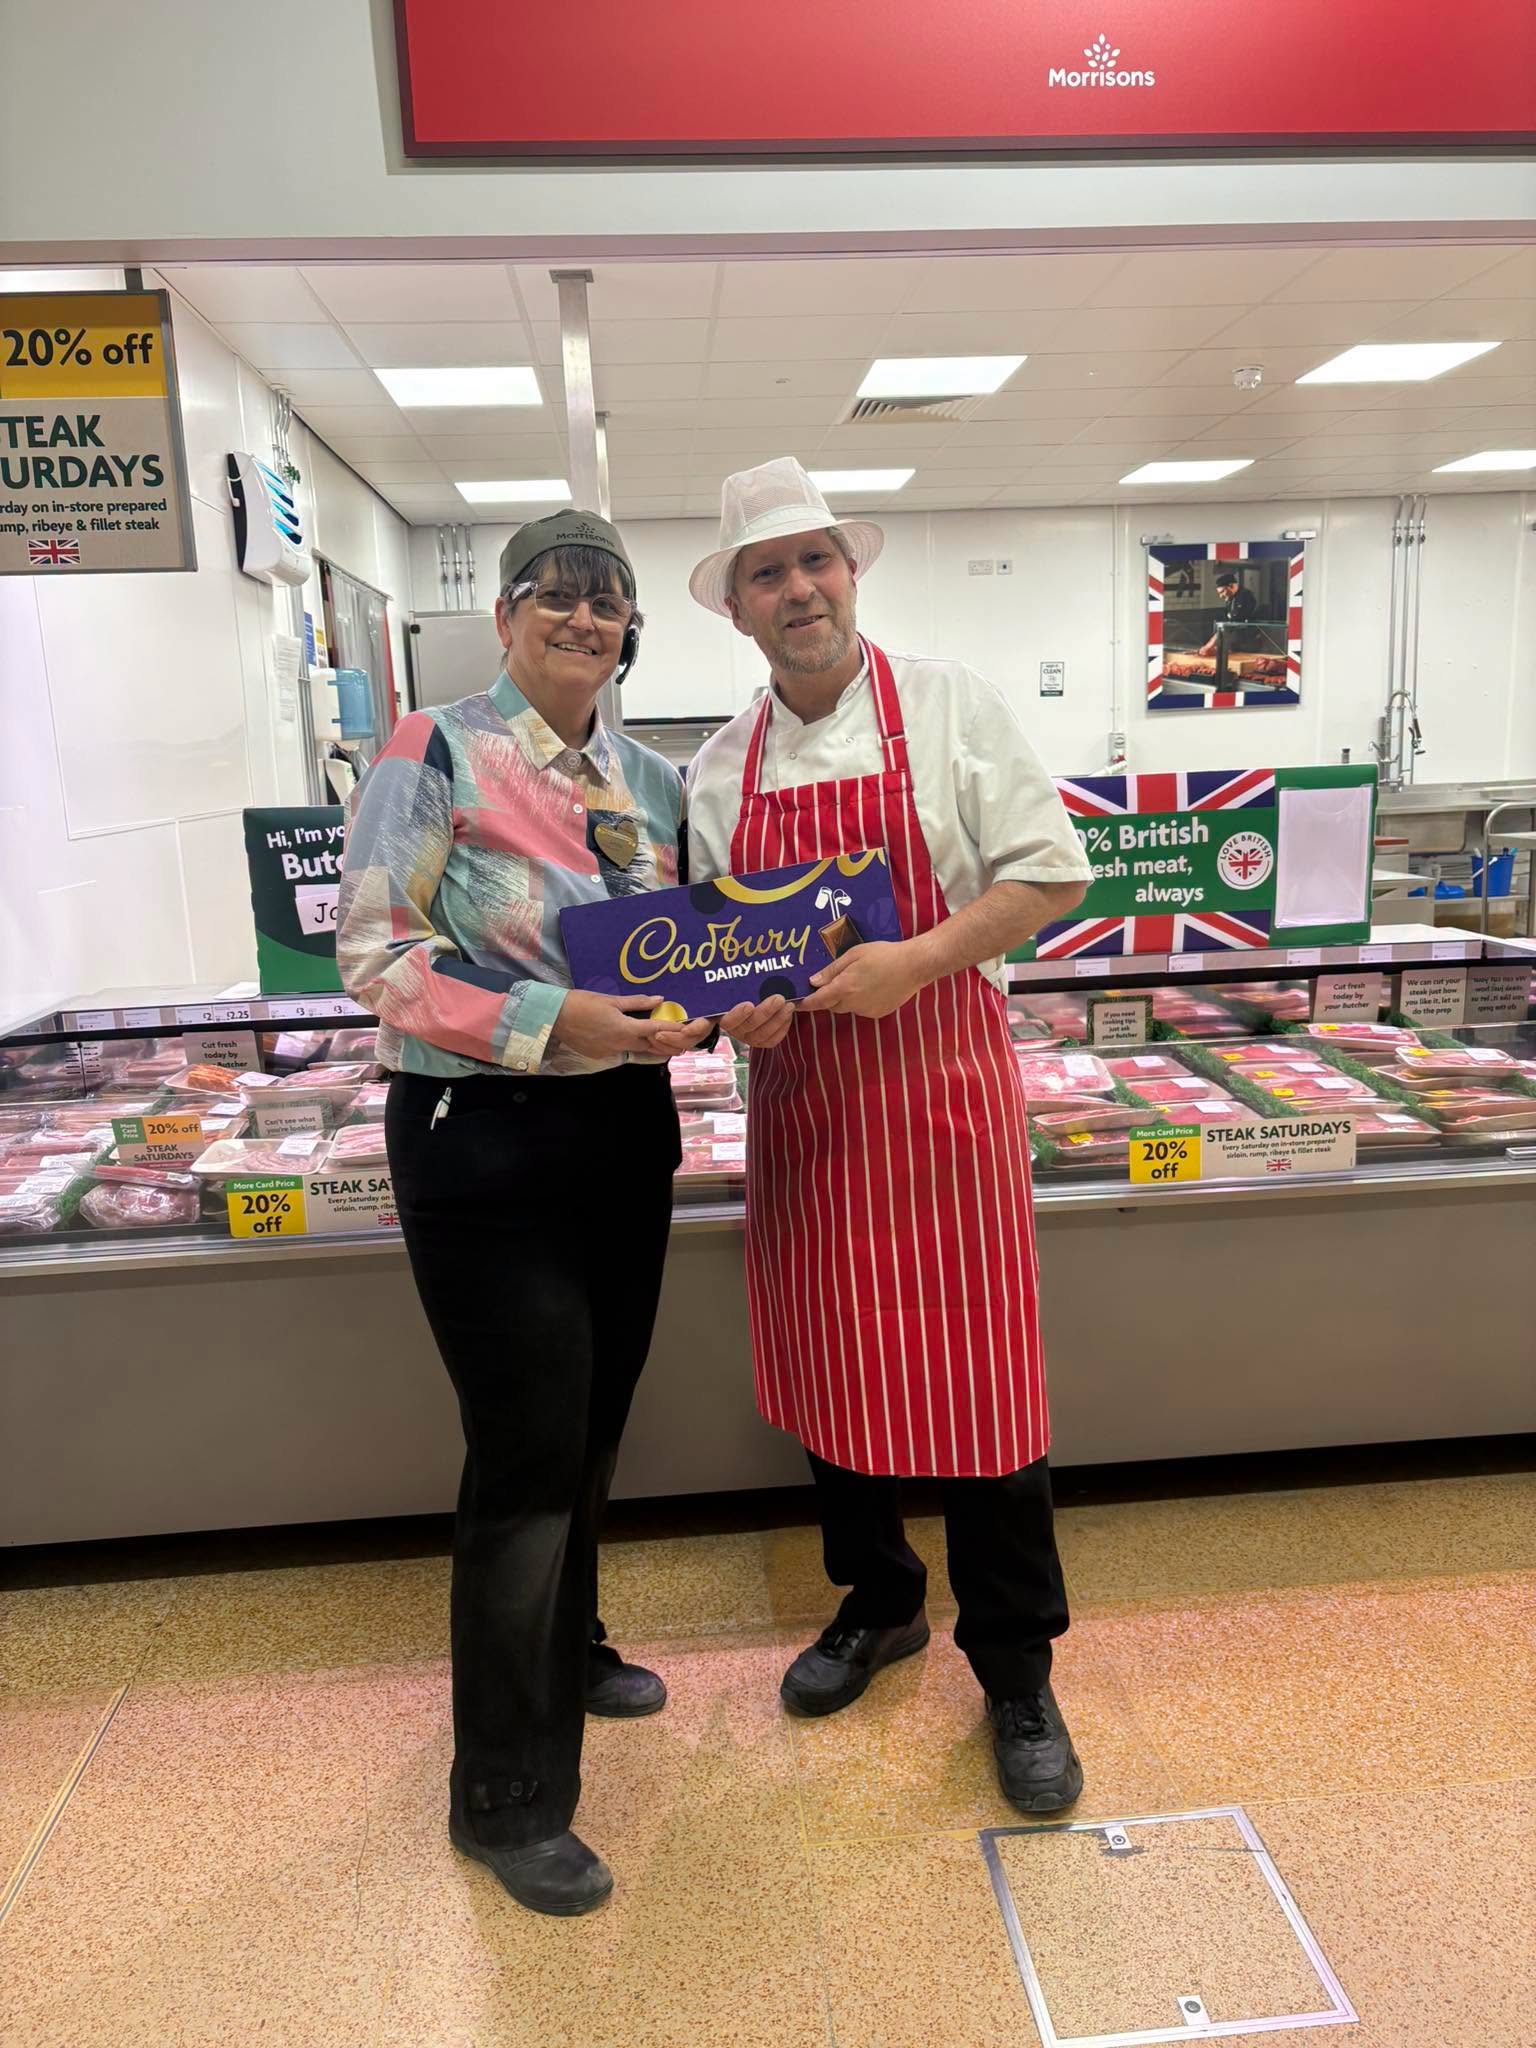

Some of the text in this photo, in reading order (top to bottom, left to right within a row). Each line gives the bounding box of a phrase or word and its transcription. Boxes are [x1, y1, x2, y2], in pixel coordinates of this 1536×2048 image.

[1048, 67, 1156, 88] Morrisons
[2, 328, 153, 366] 20% off
[0, 414, 105, 448] TEAK
[0, 454, 164, 489] URDAYS
[0, 498, 167, 516] rday on in-store prepared
[32, 519, 73, 534] ribeye
[76, 519, 87, 531] &
[90, 518, 121, 531] fillet
[125, 517, 160, 530] steak
[266, 825, 345, 849] Hi, I'm yo
[1119, 816, 1209, 850] British
[281, 850, 344, 880] Butc
[1090, 855, 1193, 879] esh meat,
[1135, 882, 1204, 907] always
[619, 914, 811, 984] Cadbury
[704, 954, 794, 984] DAIRY MILK
[1348, 982, 1366, 990] fresh
[217, 1040, 238, 1048] fresh
[148, 1123, 179, 1134] 20%
[181, 1123, 199, 1133] off
[1136, 1127, 1194, 1138] More Card Price
[1207, 1120, 1352, 1143] STEAK SATURDAYS
[146, 1144, 178, 1153] STEAK
[1142, 1141, 1188, 1161] 20%
[1222, 1144, 1240, 1152] Every
[1241, 1141, 1270, 1150] Saturday
[1280, 1139, 1306, 1147] in-store
[1307, 1137, 1337, 1147] prepared
[134, 1151, 194, 1162] SATURDAYS
[1151, 1162, 1179, 1180] off
[233, 1179, 295, 1190] More Card Price
[310, 1178, 392, 1195] STEAK SA
[241, 1193, 291, 1214] 20%
[327, 1196, 348, 1204] Every
[348, 1195, 379, 1203] Saturday
[380, 1202, 396, 1210] ribe
[253, 1216, 282, 1233] off
